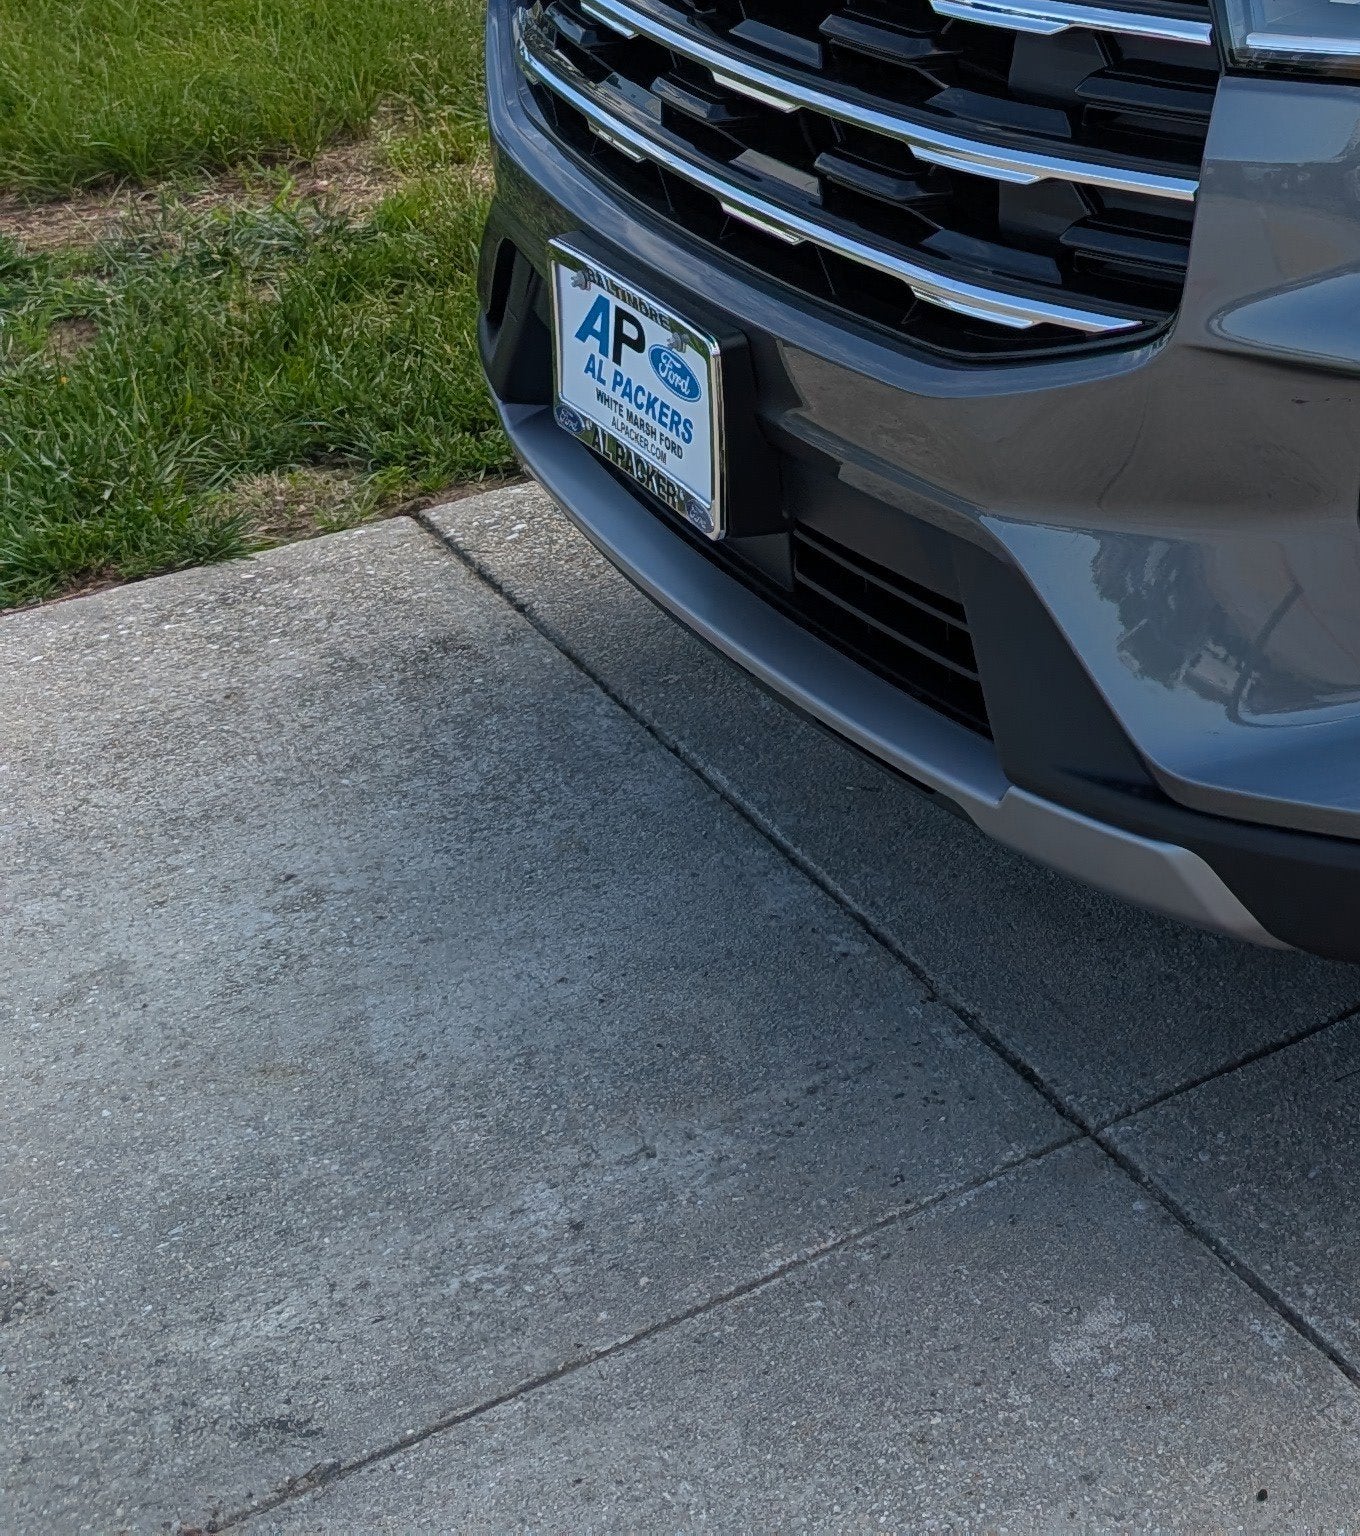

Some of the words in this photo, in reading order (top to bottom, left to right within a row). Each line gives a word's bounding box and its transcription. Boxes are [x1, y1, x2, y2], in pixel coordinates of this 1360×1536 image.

[575, 293, 646, 367] AP
[586, 267, 671, 330] BALTIMORE
[583, 353, 606, 386] AL
[612, 369, 694, 446] PACKERS
[595, 387, 625, 420] WHITE
[625, 407, 658, 442] MARSH
[659, 429, 684, 460] FORD
[611, 415, 667, 466] ALPACKER.COM
